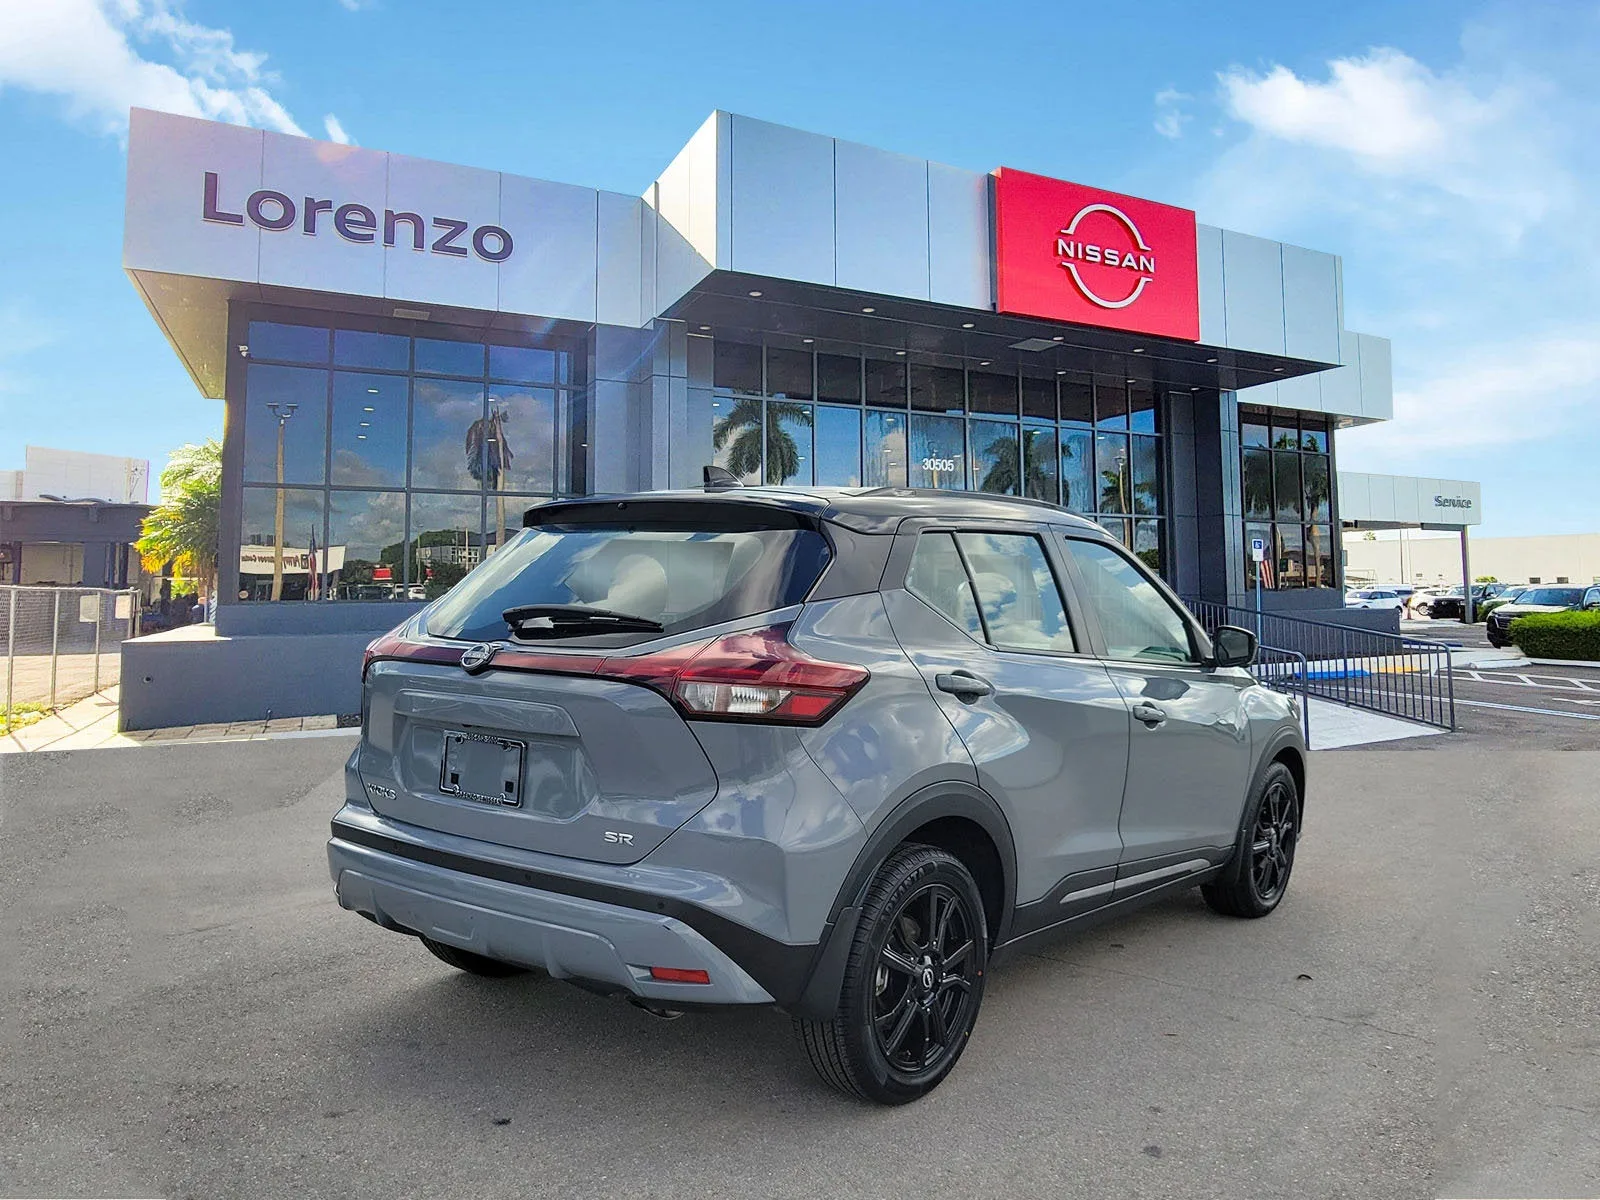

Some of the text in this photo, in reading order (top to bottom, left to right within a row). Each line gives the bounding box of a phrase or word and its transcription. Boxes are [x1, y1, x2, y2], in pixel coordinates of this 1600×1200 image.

[202, 171, 514, 263] Lorenzo
[1056, 238, 1156, 273] NISSAN
[922, 458, 954, 471] 30505
[1434, 495, 1471, 508] Service
[604, 830, 634, 847] SR
